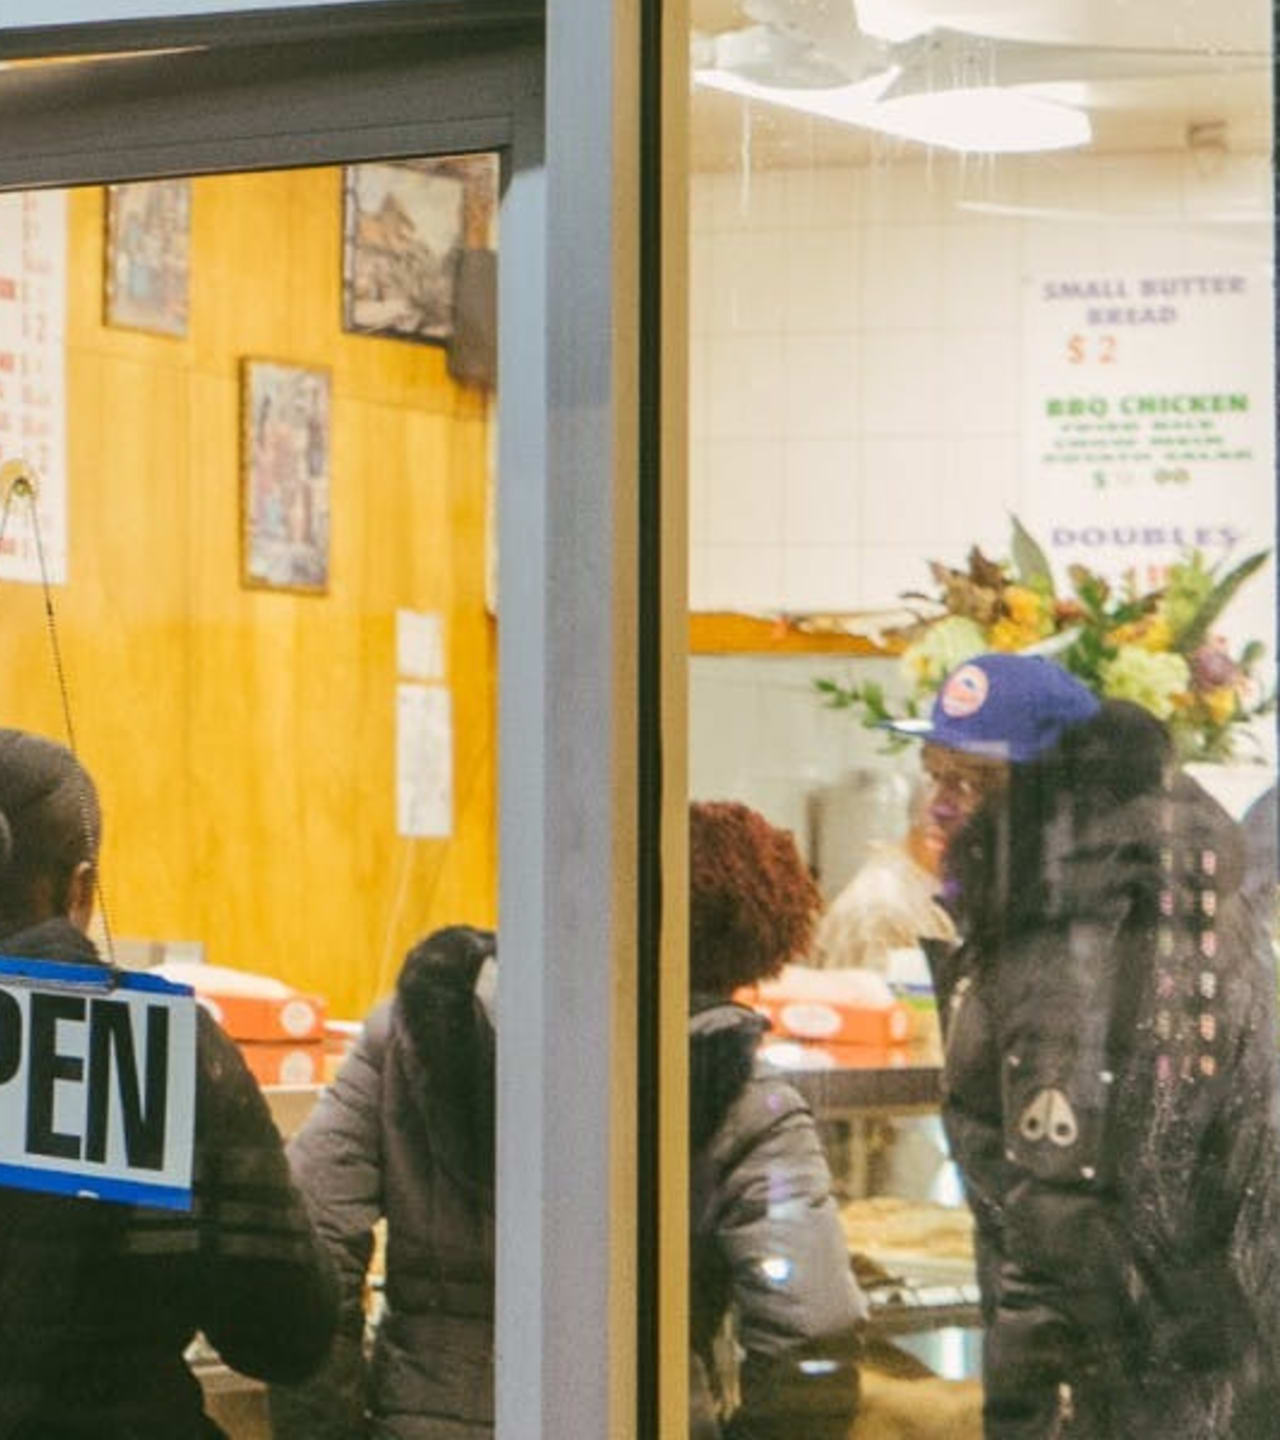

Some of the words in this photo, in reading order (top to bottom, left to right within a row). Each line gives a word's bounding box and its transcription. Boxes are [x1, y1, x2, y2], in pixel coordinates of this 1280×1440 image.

[1042, 280, 1129, 302] SMALL
[1139, 276, 1246, 298] BUTTER
[1087, 308, 1178, 328] BREAD
[1044, 396, 1109, 418] BBQ
[1120, 392, 1250, 415] CHICKEN
